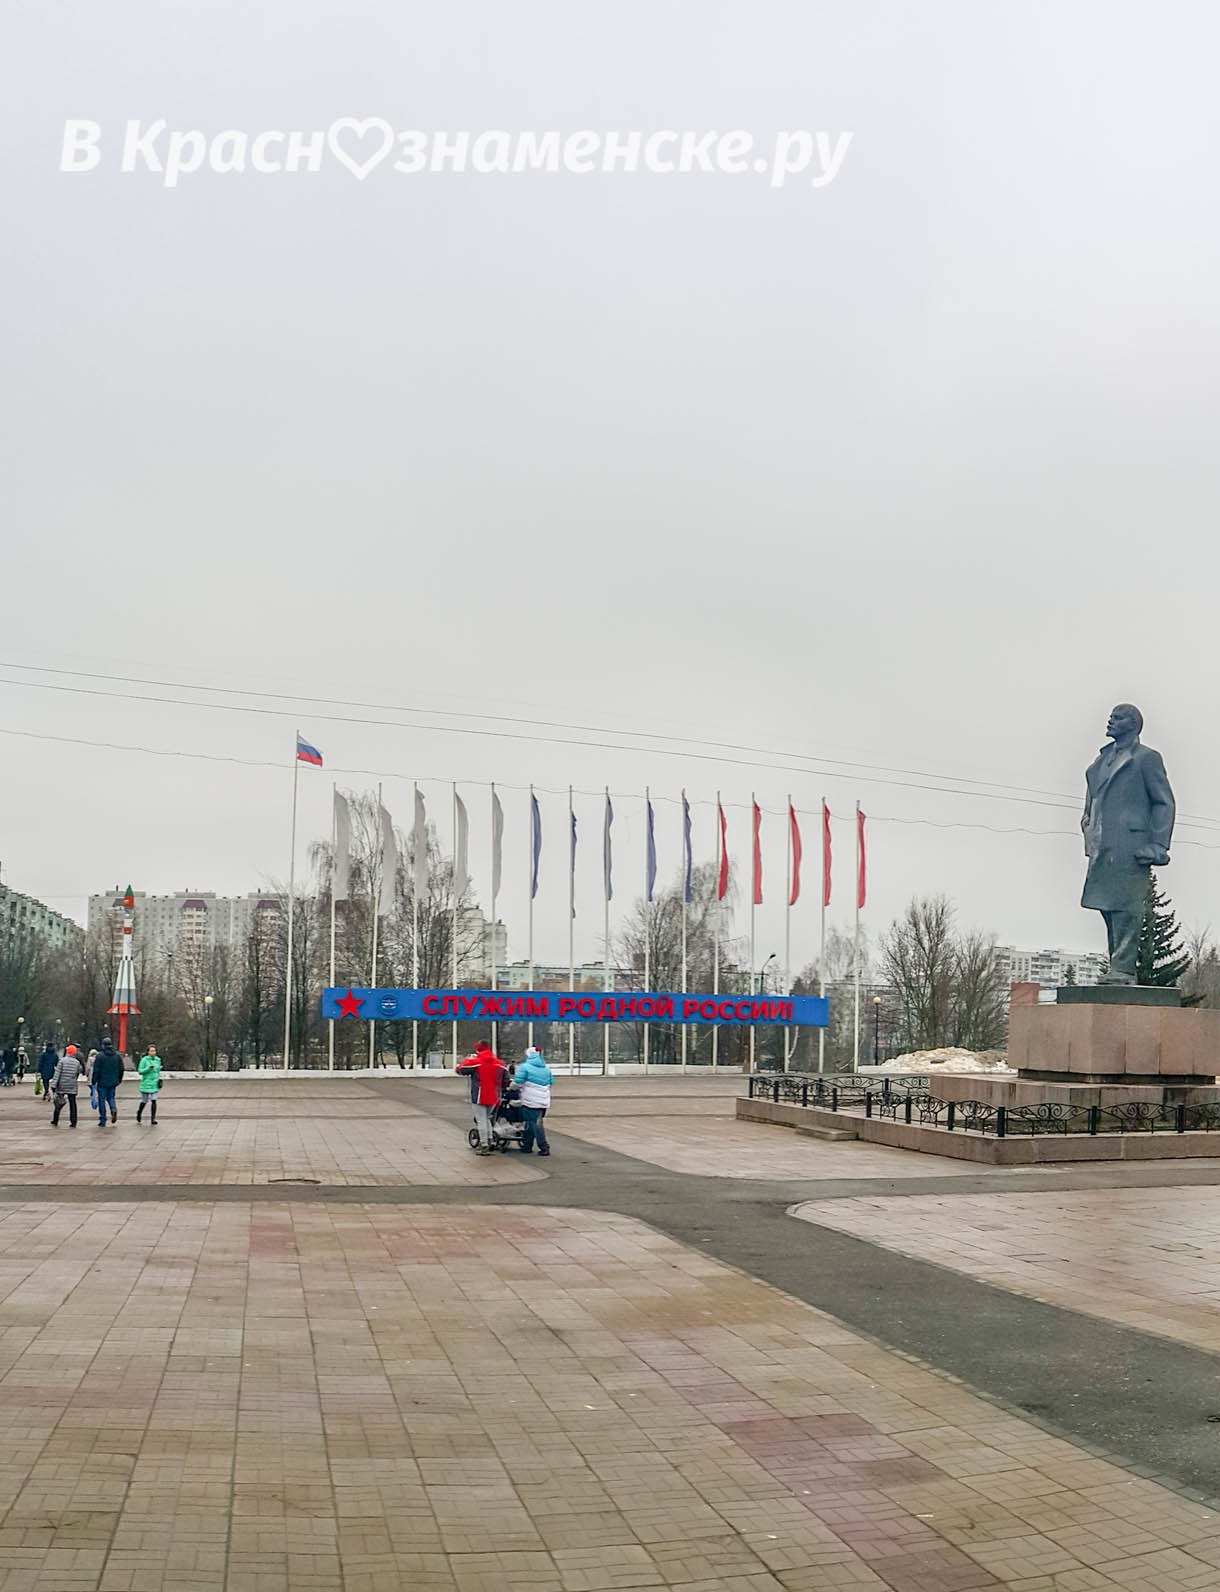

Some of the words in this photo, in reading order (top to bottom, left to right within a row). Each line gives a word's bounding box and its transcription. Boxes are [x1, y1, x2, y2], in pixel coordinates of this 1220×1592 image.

[422, 995, 549, 1016] СЛУЖИМ
[558, 995, 674, 1020] РОДНОЙ
[683, 999, 793, 1021] РОССИИ!
